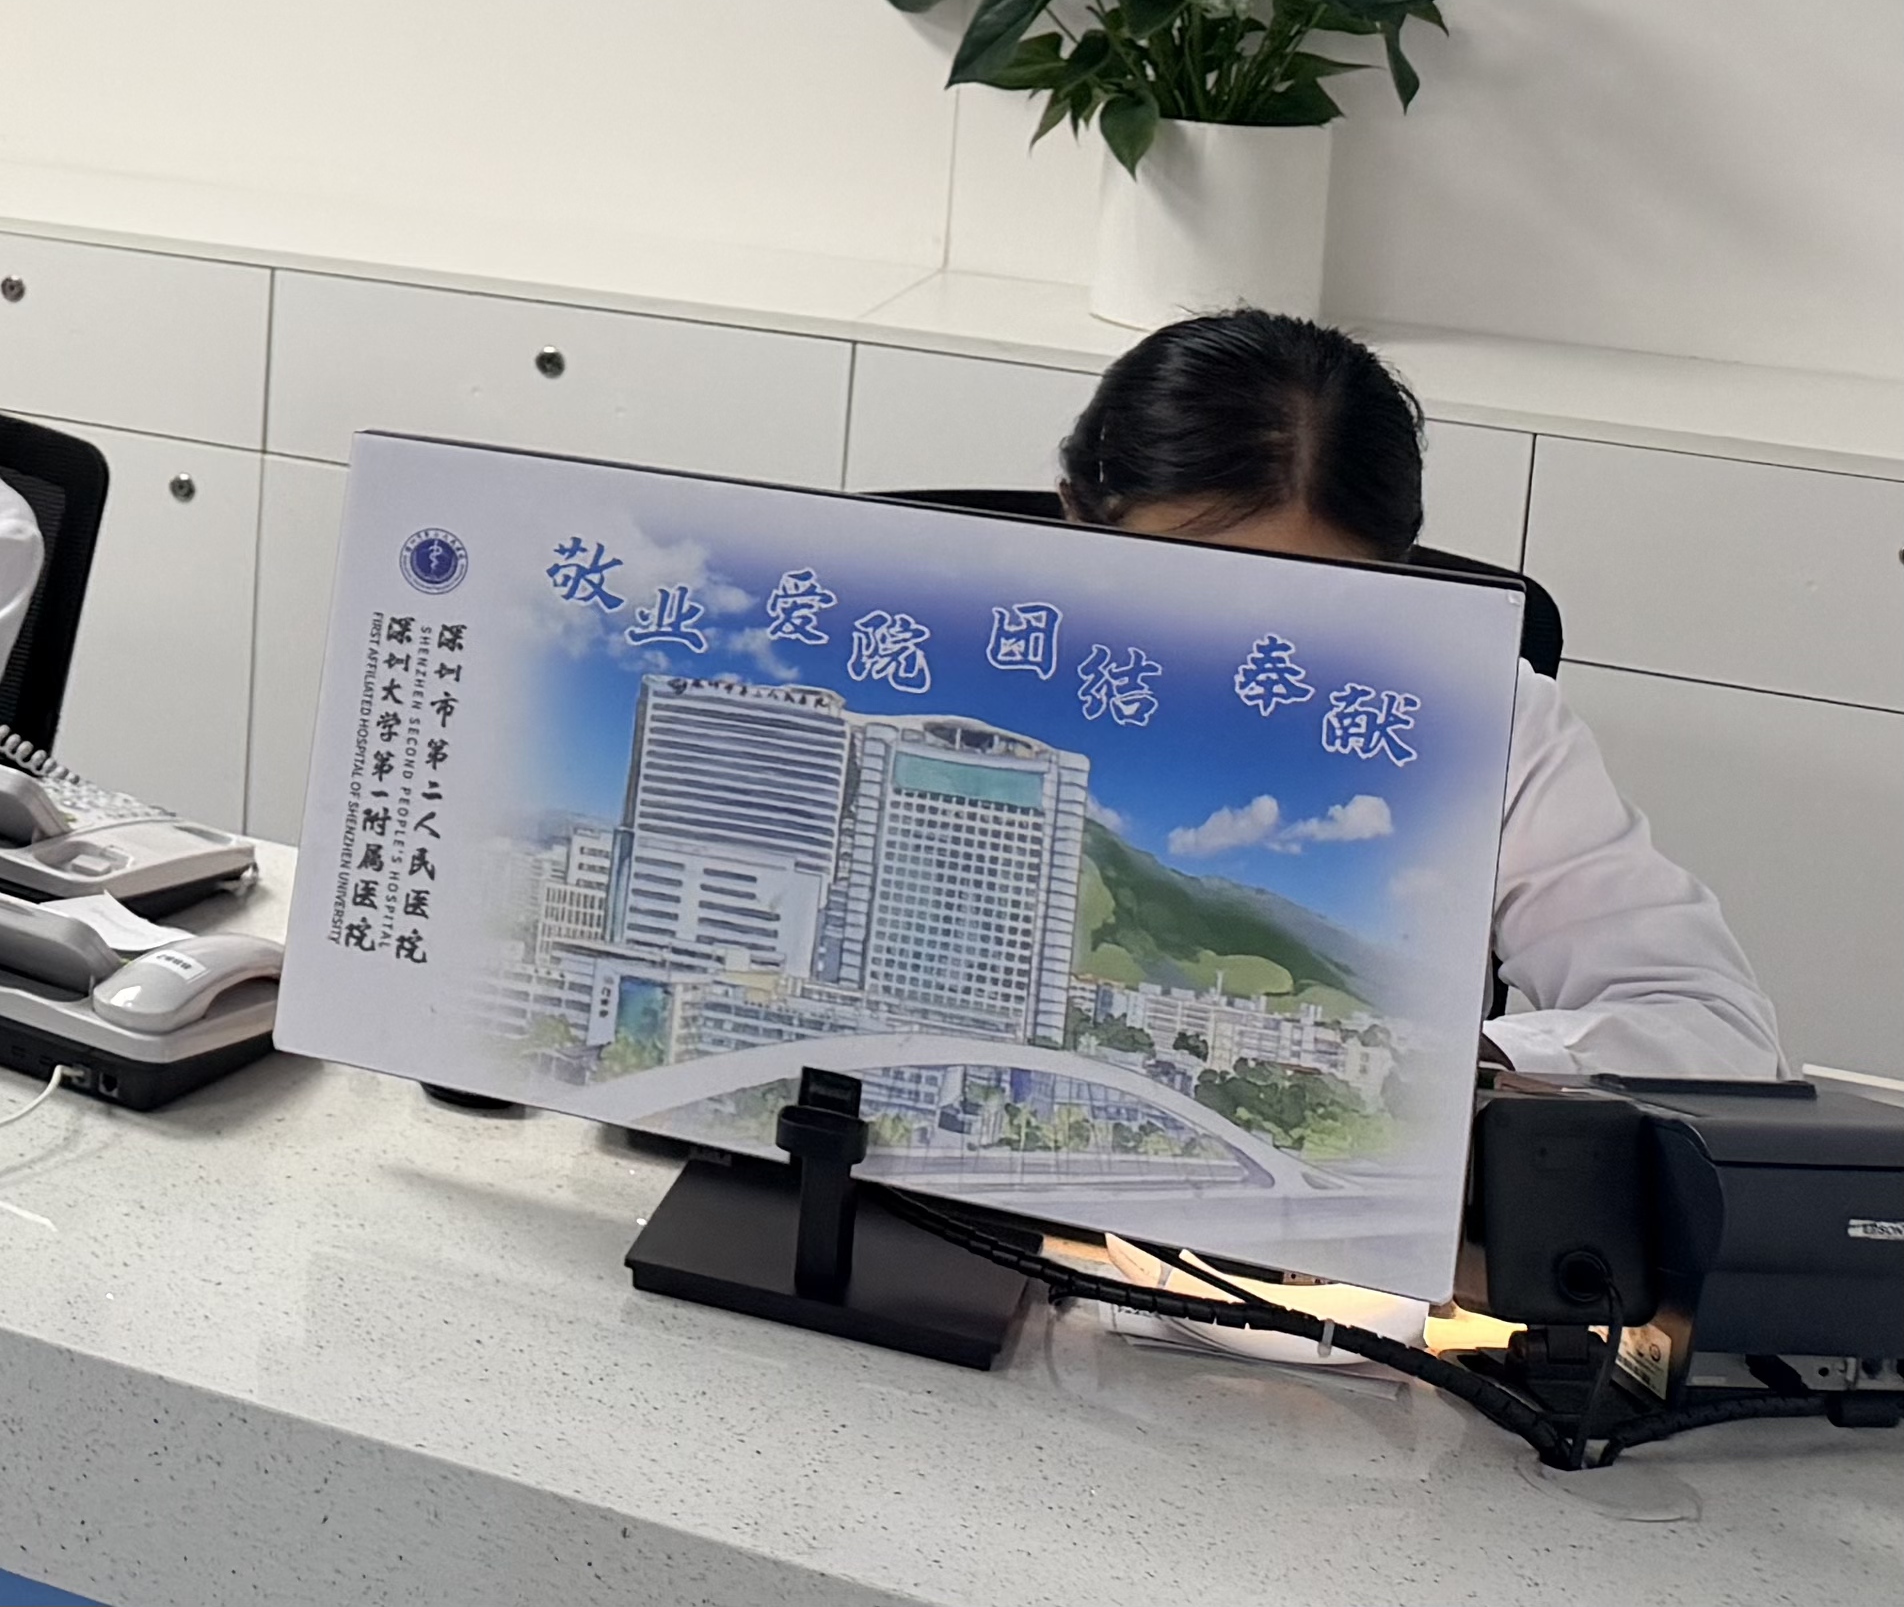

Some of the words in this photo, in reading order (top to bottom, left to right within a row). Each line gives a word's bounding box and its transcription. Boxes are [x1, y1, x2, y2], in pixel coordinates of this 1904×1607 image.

[368, 611, 384, 646] FIRST
[545, 535, 709, 654] 敬业
[766, 566, 932, 695] 爱院
[1234, 632, 1421, 766] 奉献
[360, 647, 379, 716] AFFILIATED
[411, 625, 432, 710] SHENZHEN
[351, 718, 369, 778] HOSPITAL
[402, 717, 421, 780] SECOND
[349, 781, 362, 799] OF
[341, 800, 359, 870] SHENZHEN
[328, 871, 351, 945] UNIVERSITY
[378, 870, 400, 948] HOSPITAL
